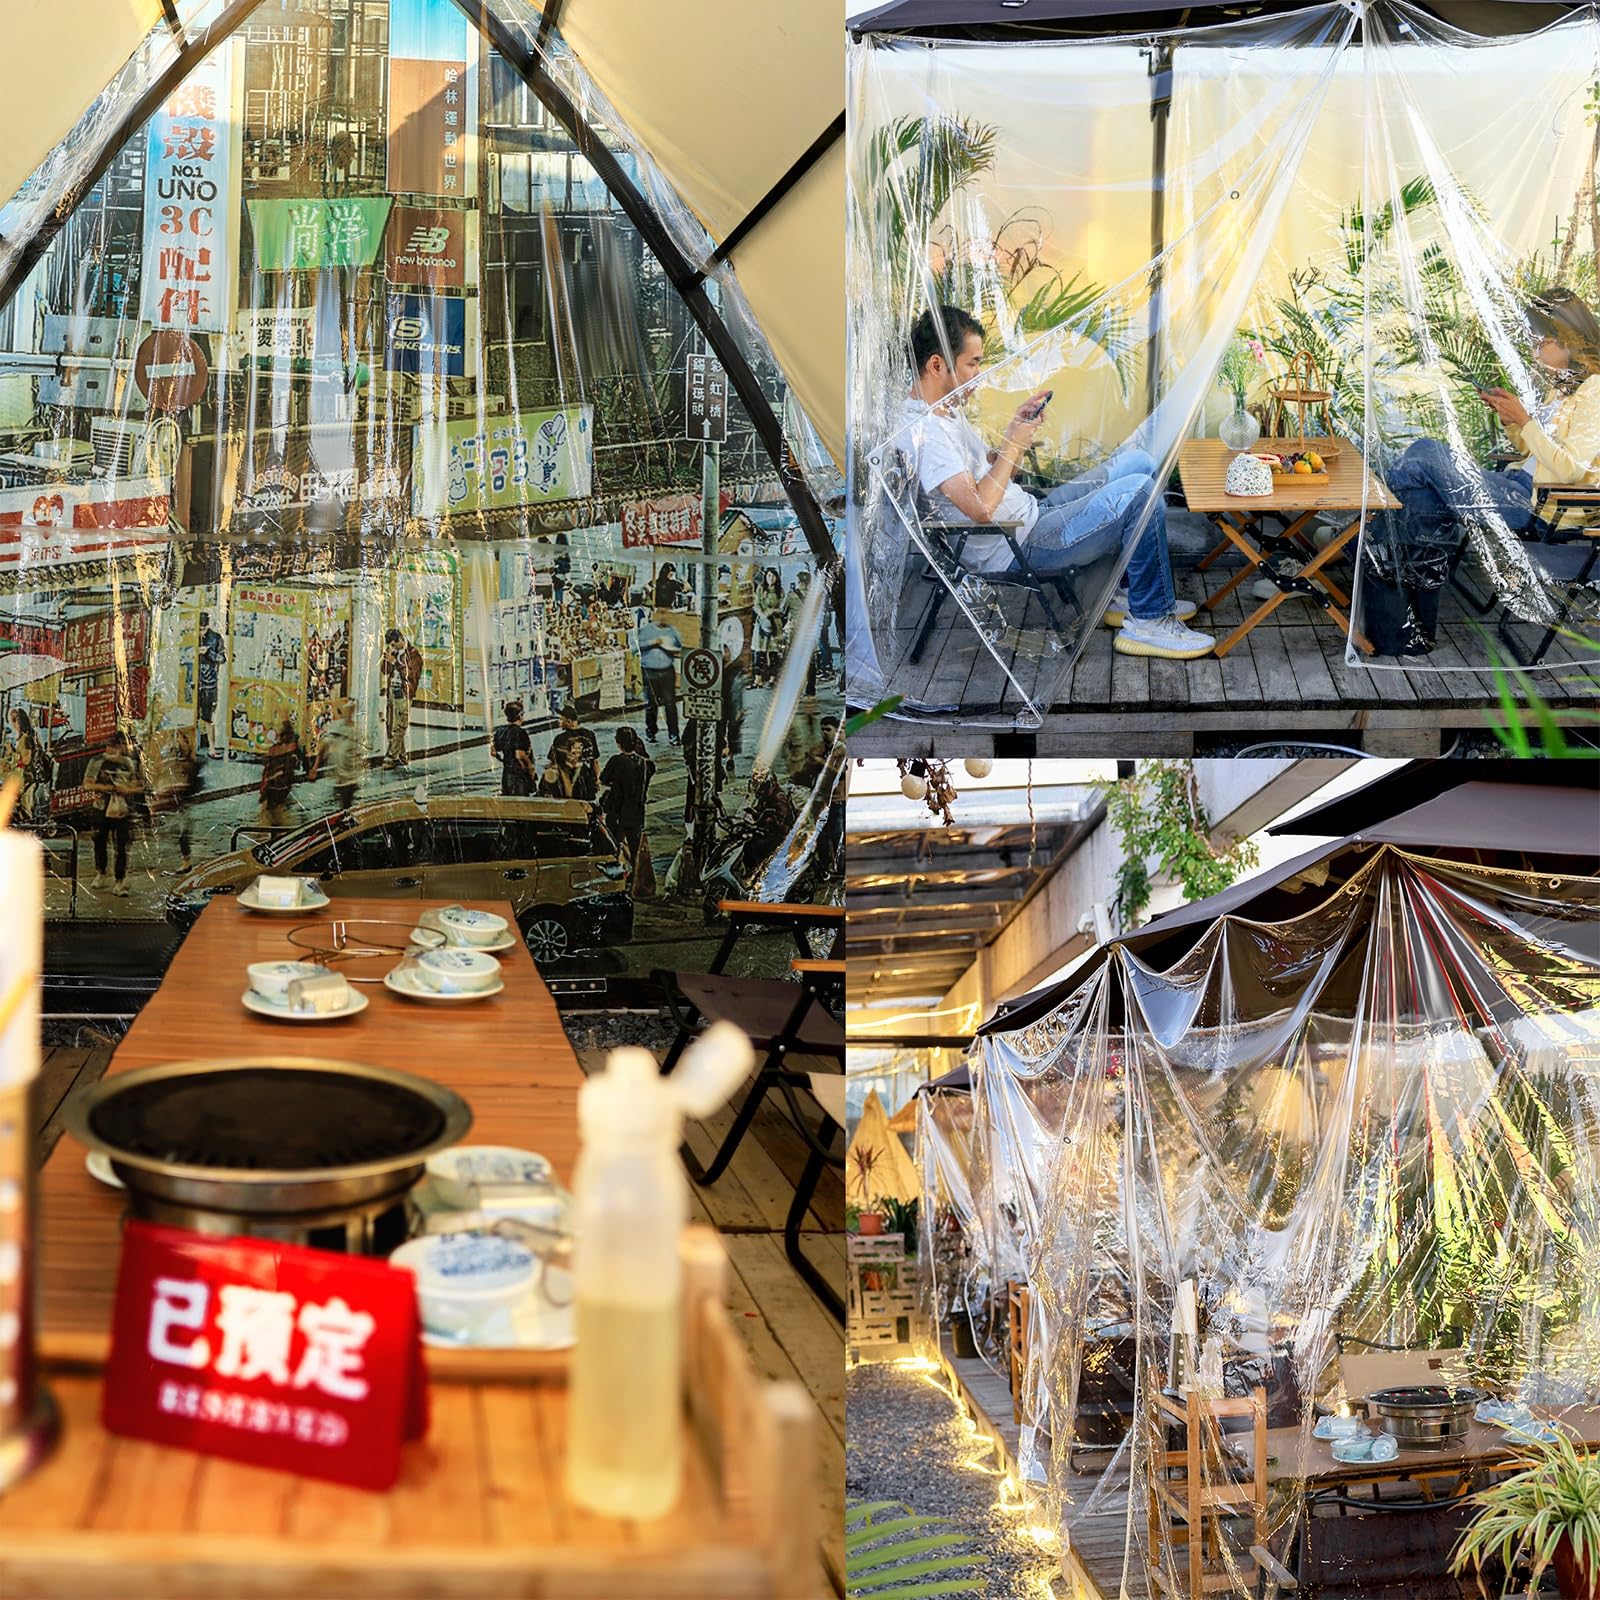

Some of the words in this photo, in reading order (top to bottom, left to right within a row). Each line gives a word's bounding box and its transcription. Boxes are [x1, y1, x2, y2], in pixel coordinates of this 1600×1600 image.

[444, 68, 458, 190] 哈林運動世界
[172, 165, 203, 177] NO.1
[158, 178, 217, 201] UNO
[160, 205, 213, 236] 3C
[396, 255, 415, 265] new
[416, 256, 456, 267] balance
[158, 246, 212, 325] 配件
[393, 341, 461, 354] SKECHERS
[709, 359, 723, 418] 彩虹橋
[691, 658, 713, 682] 停
[148, 1277, 376, 1401] 已預定
